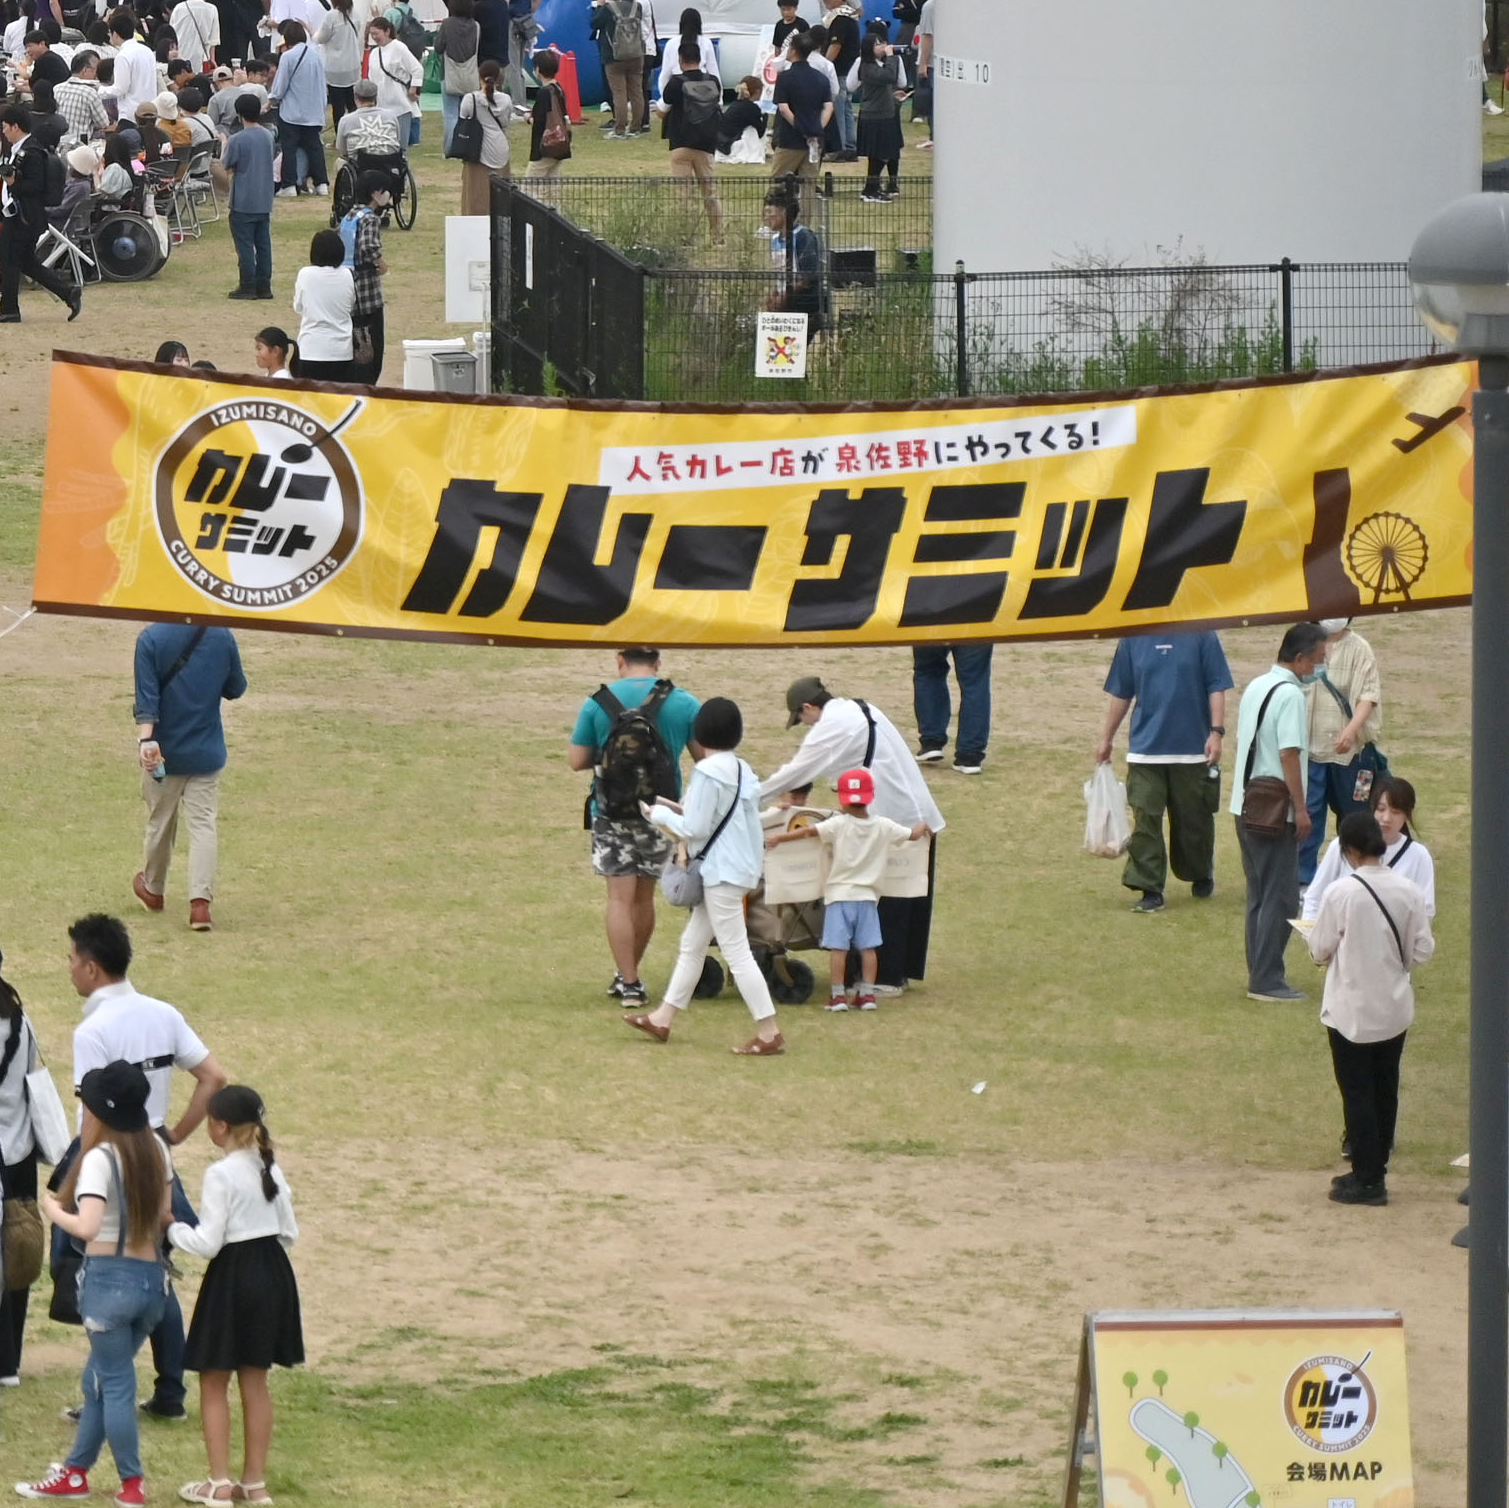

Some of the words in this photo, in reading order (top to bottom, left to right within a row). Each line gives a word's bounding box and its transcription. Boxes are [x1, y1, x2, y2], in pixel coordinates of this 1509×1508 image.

[975, 63, 989, 84] 10
[210, 403, 317, 436] IZUMISANO
[184, 448, 331, 512] カレー
[195, 512, 317, 558] サミット
[401, 467, 1247, 631] カレーサミット
[170, 539, 220, 591] CURRY
[221, 584, 293, 605] SUMMIT
[296, 556, 338, 593] 2025
[1298, 1379, 1362, 1408] カレー
[1304, 1410, 1359, 1429] サミット
[1286, 1460, 1384, 1481] 会場MAP
